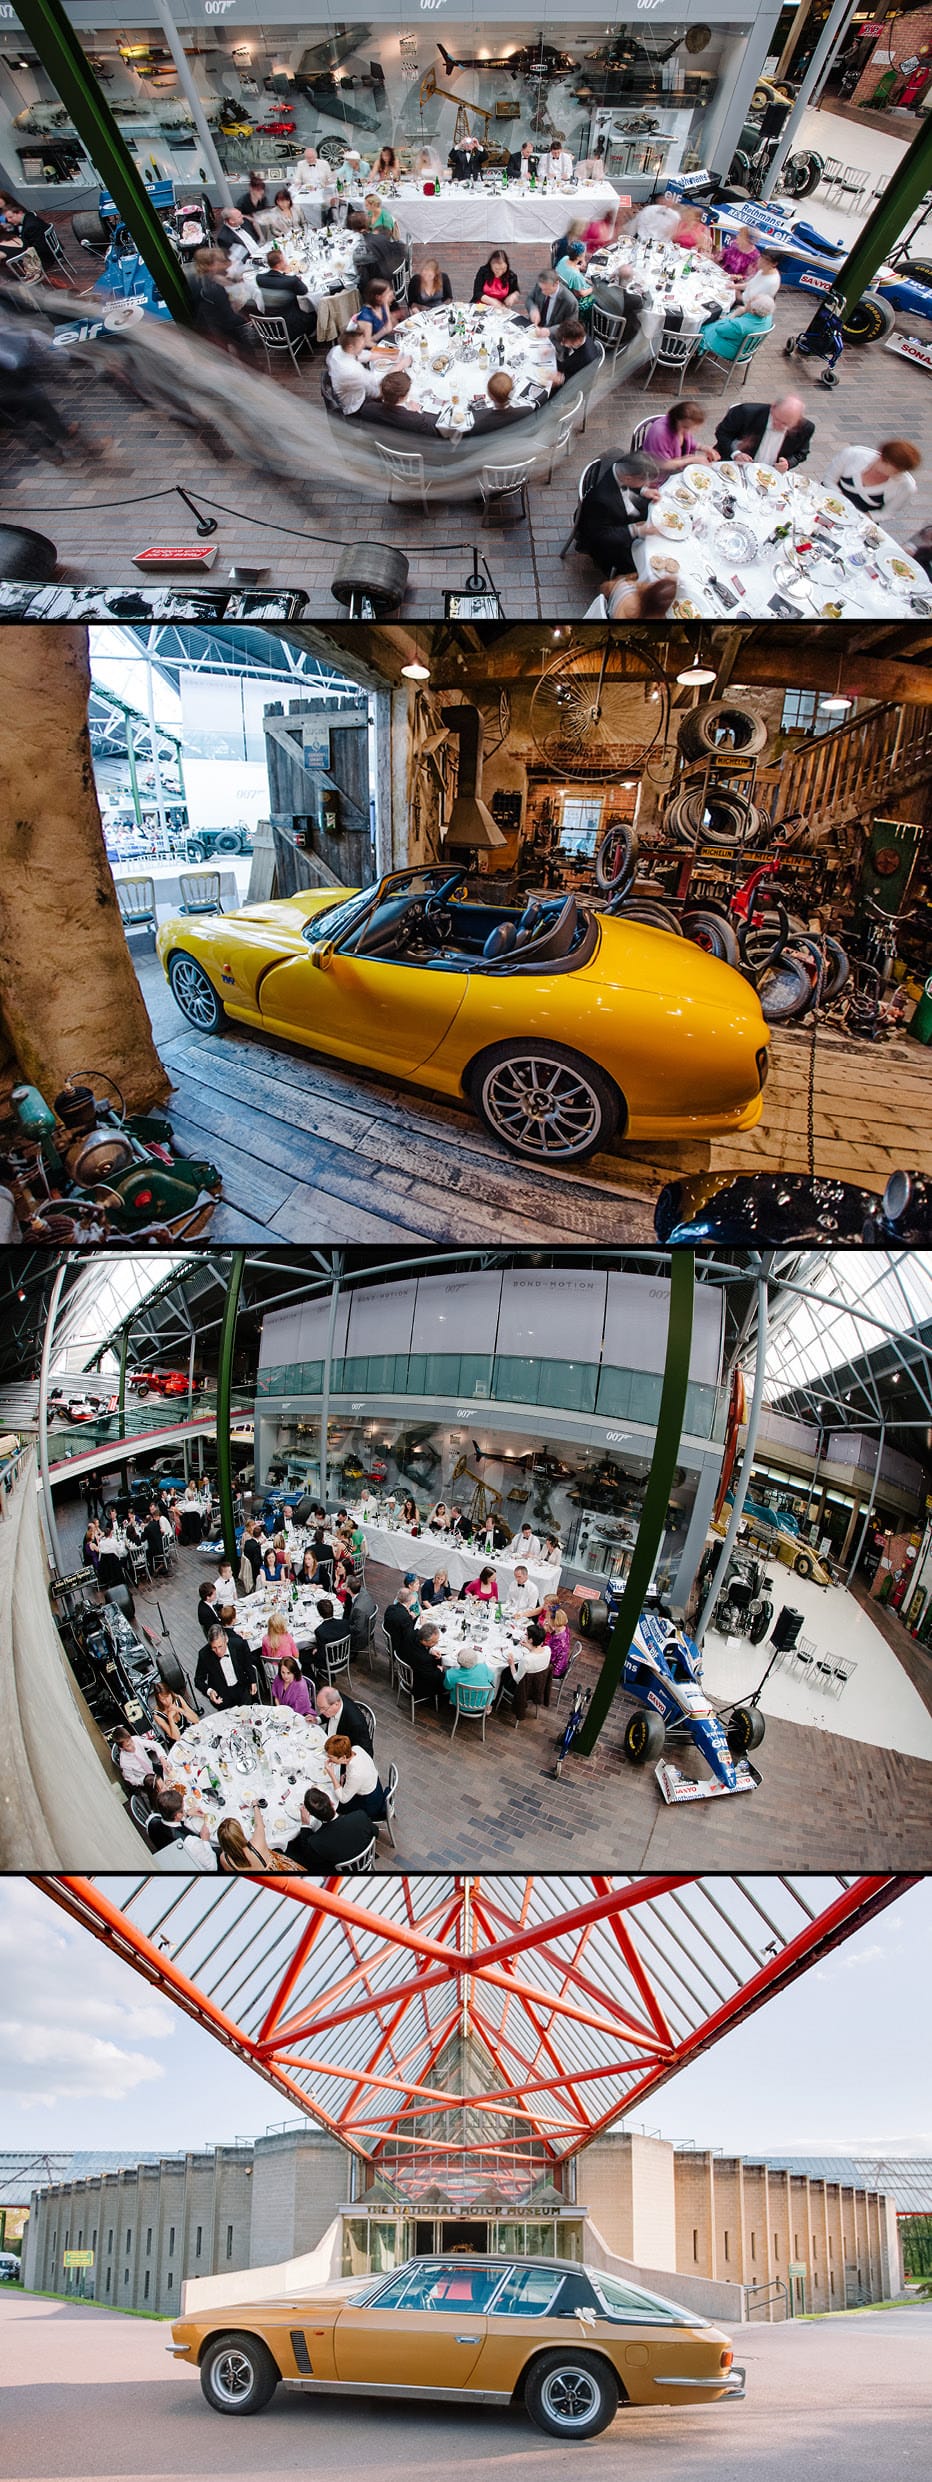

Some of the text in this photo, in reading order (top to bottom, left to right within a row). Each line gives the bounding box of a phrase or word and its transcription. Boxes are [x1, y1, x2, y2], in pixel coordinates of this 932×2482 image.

[204, 1, 229, 14] 007
[420, 0, 441, 9] 007
[741, 203, 781, 226] Rothmans
[774, 231, 793, 244] elf
[800, 275, 832, 291] SANYO
[52, 322, 103, 346] elf
[702, 848, 733, 857] MICHELIN
[513, 1280, 543, 1288] BOND
[550, 1280, 595, 1289] MOTION
[456, 1408, 473, 1418] 007
[606, 1431, 628, 1442] 007
[648, 1692, 665, 1713] SANYO
[124, 1699, 144, 1723] 5
[367, 2205, 560, 2215] THE NATIONAL MOTOR MUSEUM
